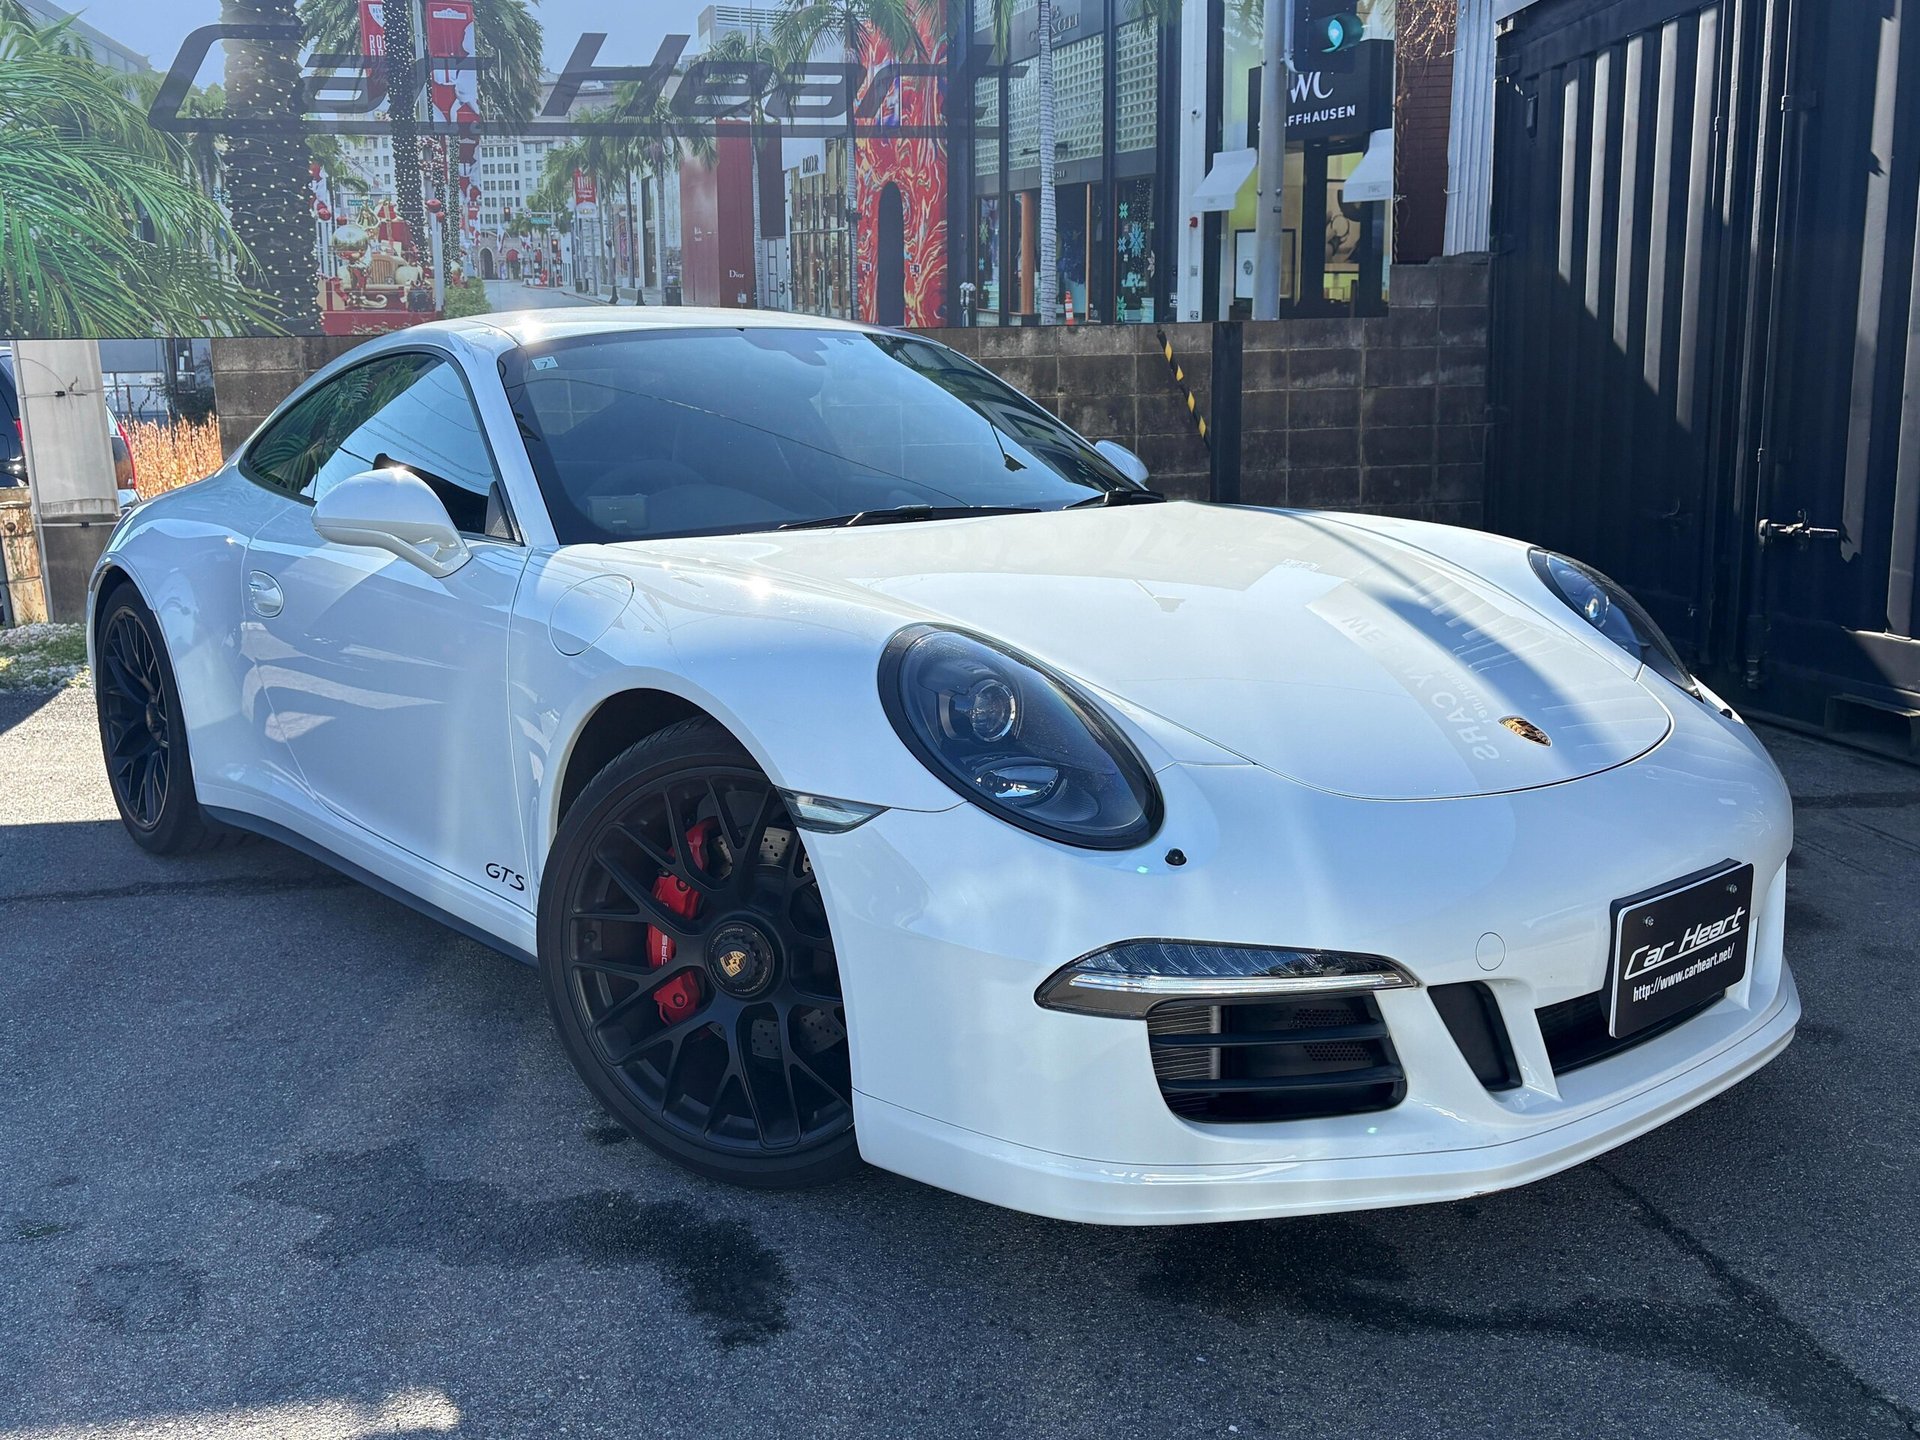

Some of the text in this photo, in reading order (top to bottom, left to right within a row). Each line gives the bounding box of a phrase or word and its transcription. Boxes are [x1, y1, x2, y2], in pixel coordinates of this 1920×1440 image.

[148, 24, 1030, 132] Car Heart
[1290, 71, 1334, 104] WC
[1258, 104, 1356, 131] FFHAUSEN
[802, 154, 819, 174] DIOR
[729, 269, 745, 279] Dior
[485, 862, 525, 891] GTS
[1623, 906, 1746, 980] Car Heart
[1632, 942, 1736, 1003] http://www.carheart.net/
